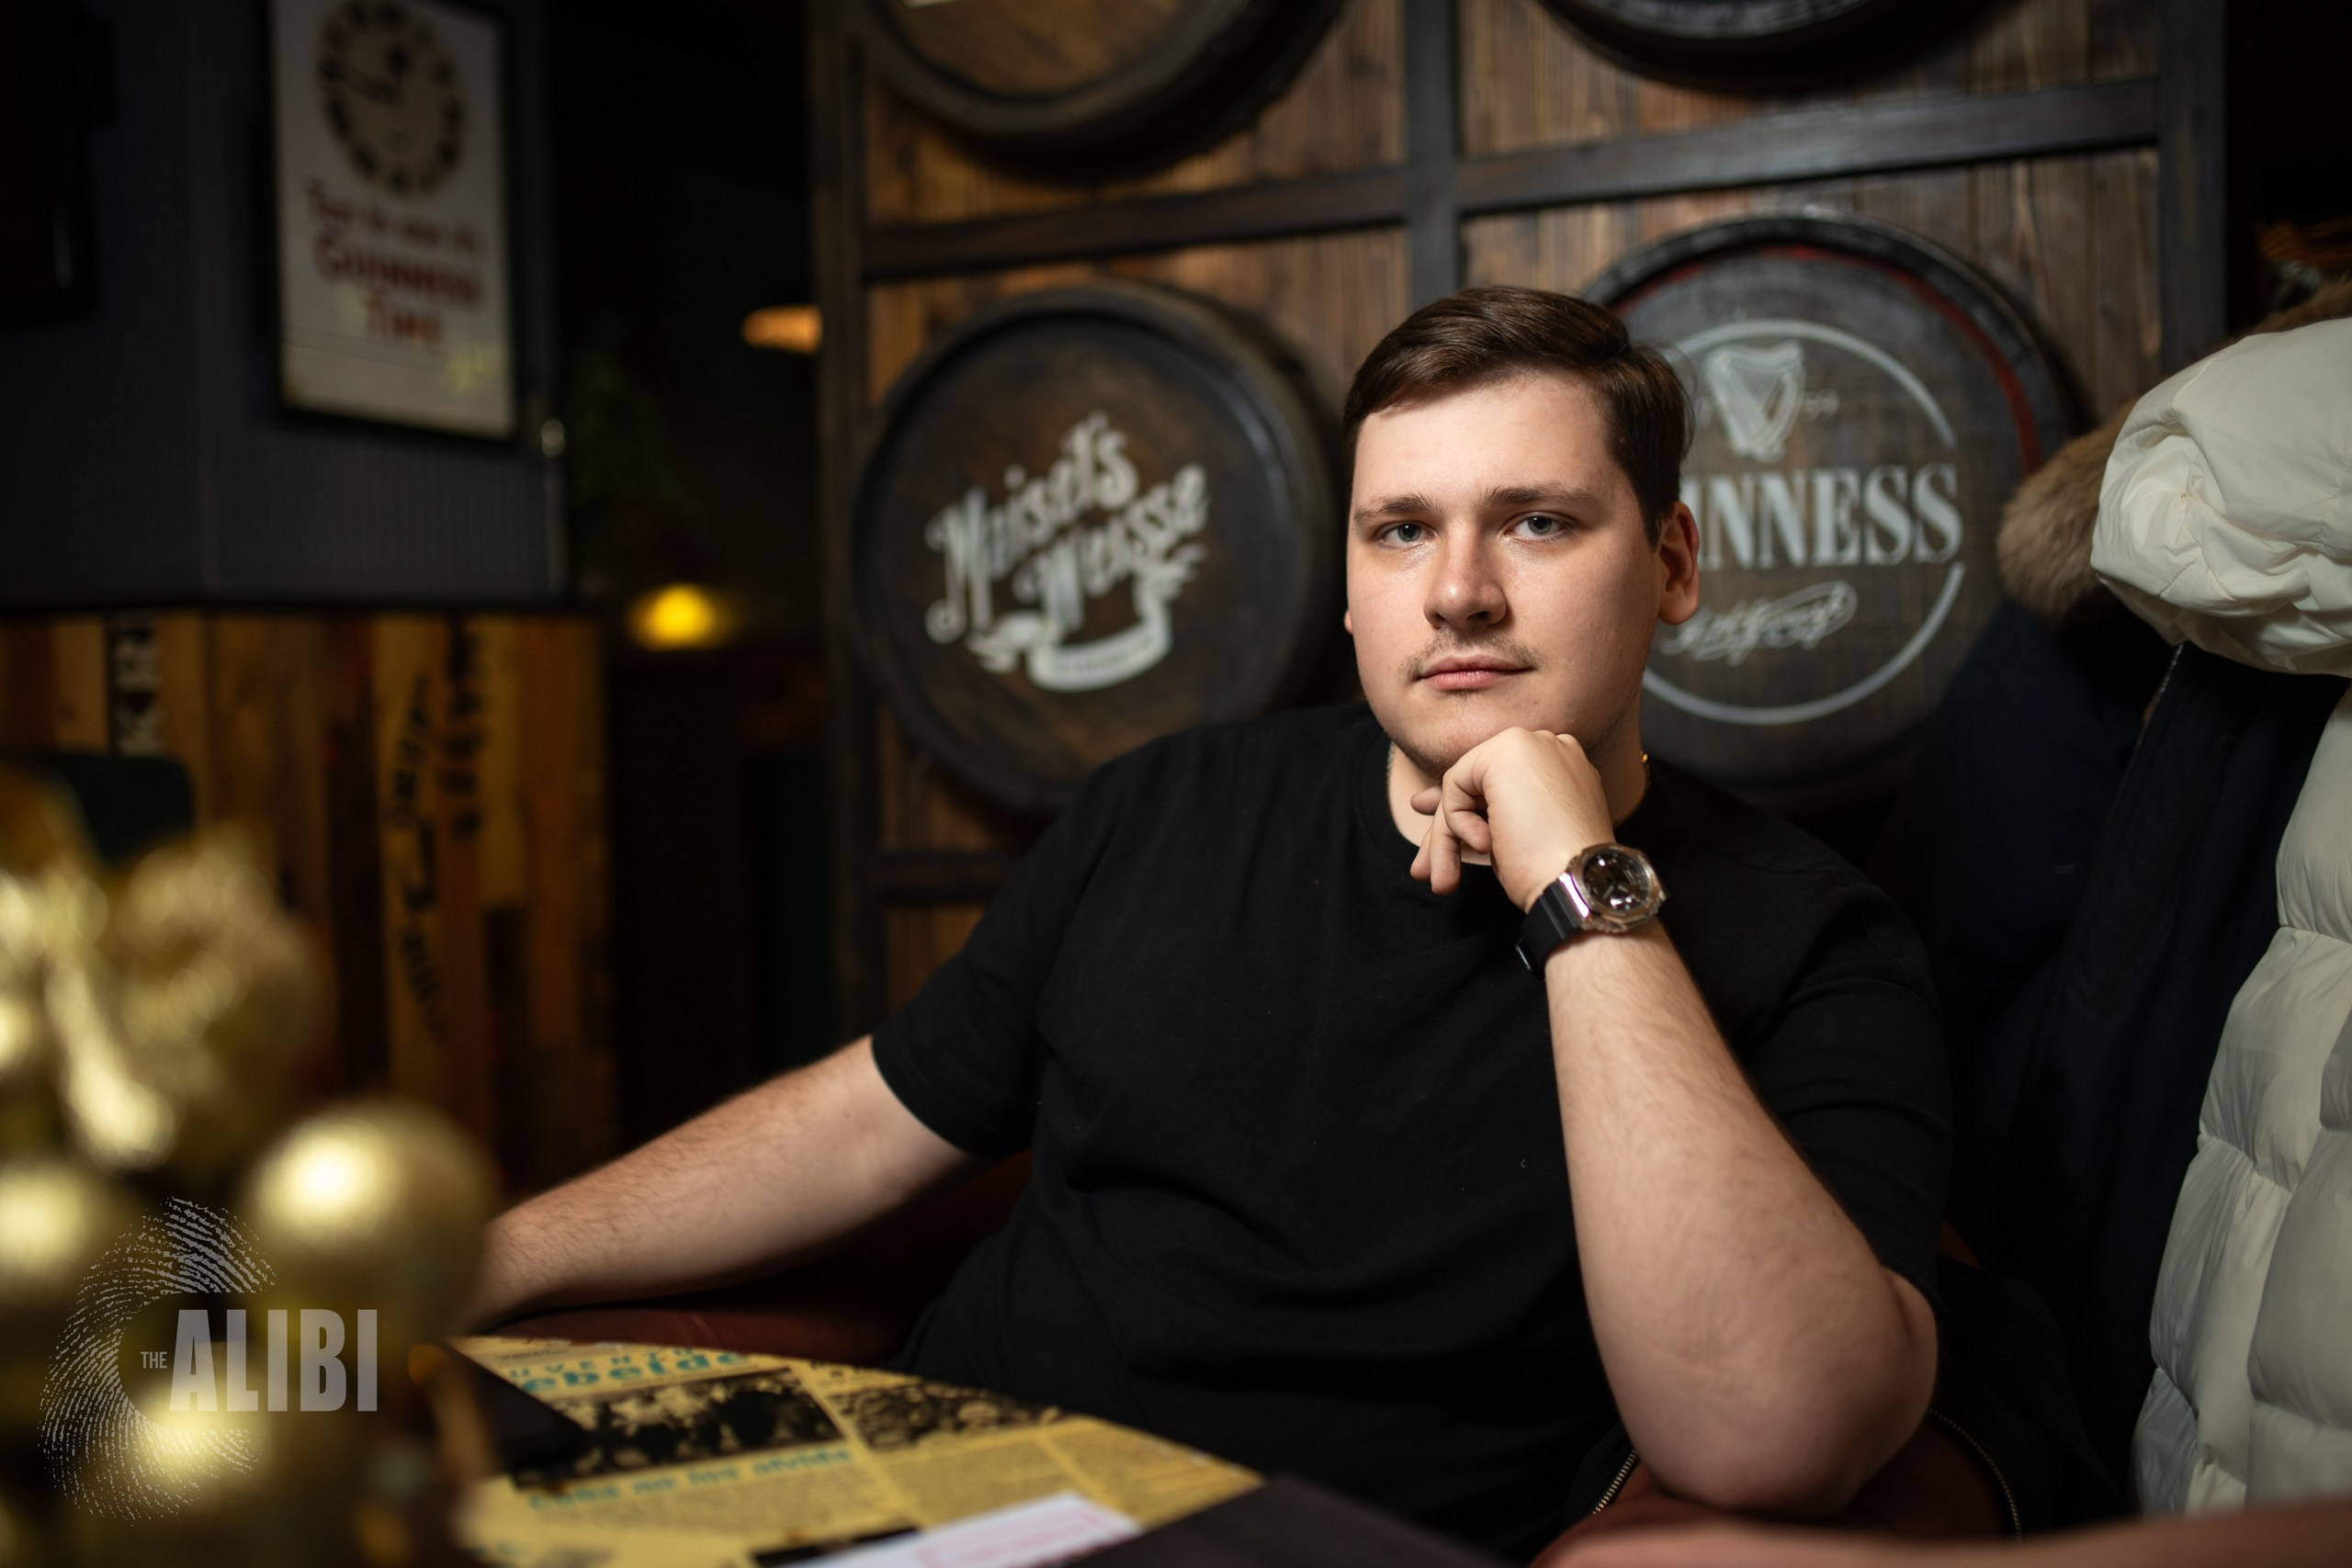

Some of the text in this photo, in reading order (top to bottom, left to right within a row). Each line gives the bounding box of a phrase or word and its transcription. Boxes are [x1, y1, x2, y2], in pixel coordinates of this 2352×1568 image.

[1679, 461, 1963, 571] INNESS
[508, 1348, 693, 1377] UVENTU
[520, 1351, 752, 1393] ebelde
